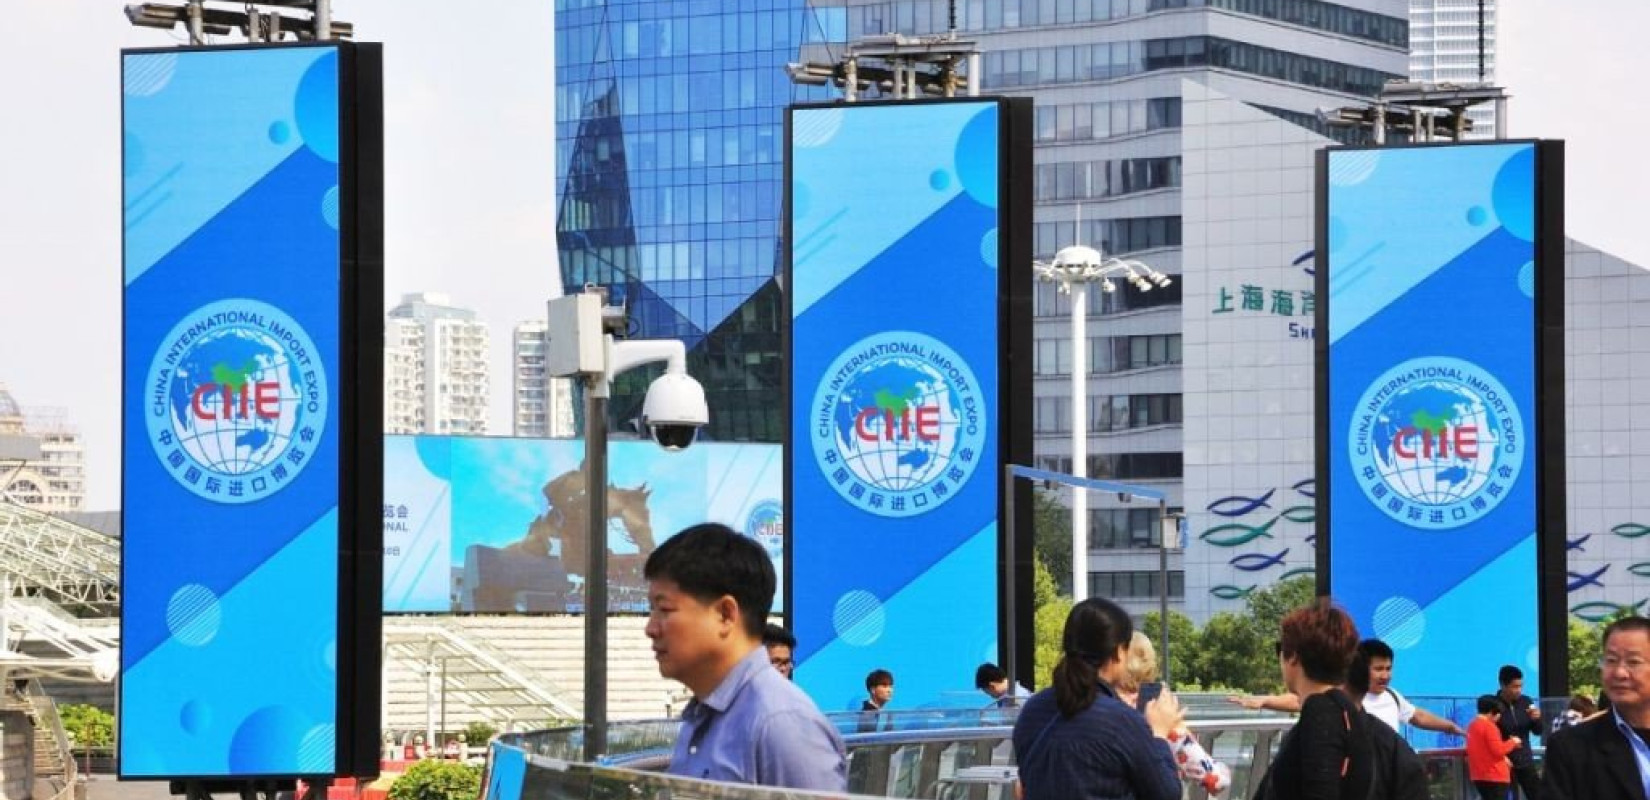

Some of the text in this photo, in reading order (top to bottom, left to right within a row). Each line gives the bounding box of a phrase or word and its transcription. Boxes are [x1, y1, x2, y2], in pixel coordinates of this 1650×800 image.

[154, 310, 318, 417] CHINA INTERNATIONAL IMPORT EXPO
[819, 342, 977, 438] CHINA INTERNATIONAL IMPORT EXPO
[192, 382, 280, 419] CIIE
[855, 405, 940, 442] CIIE
[1357, 367, 1515, 455] CHINA INTERNATIONAL IMPORT EXPO
[159, 427, 314, 496] 中国国际进口博览会
[1393, 426, 1478, 459] CIIE
